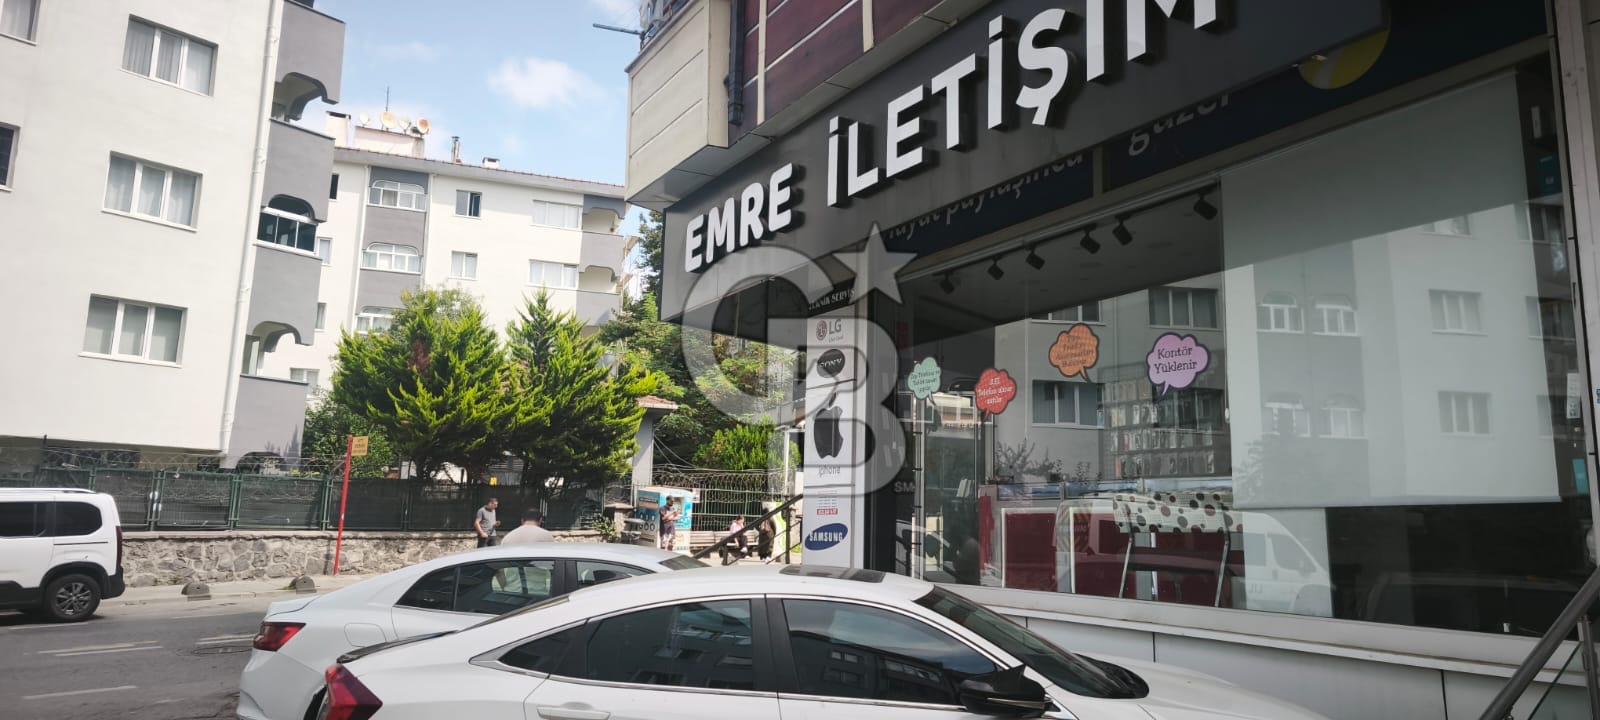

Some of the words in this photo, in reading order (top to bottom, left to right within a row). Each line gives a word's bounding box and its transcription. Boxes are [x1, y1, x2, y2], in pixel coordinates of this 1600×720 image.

[685, 162, 794, 274] EMRE
[829, 319, 842, 334] LG
[1157, 346, 1193, 359] Kontör
[819, 358, 842, 368] SONY
[1154, 359, 1198, 374] Yüklenir
[809, 531, 843, 542] SAMSUNG
